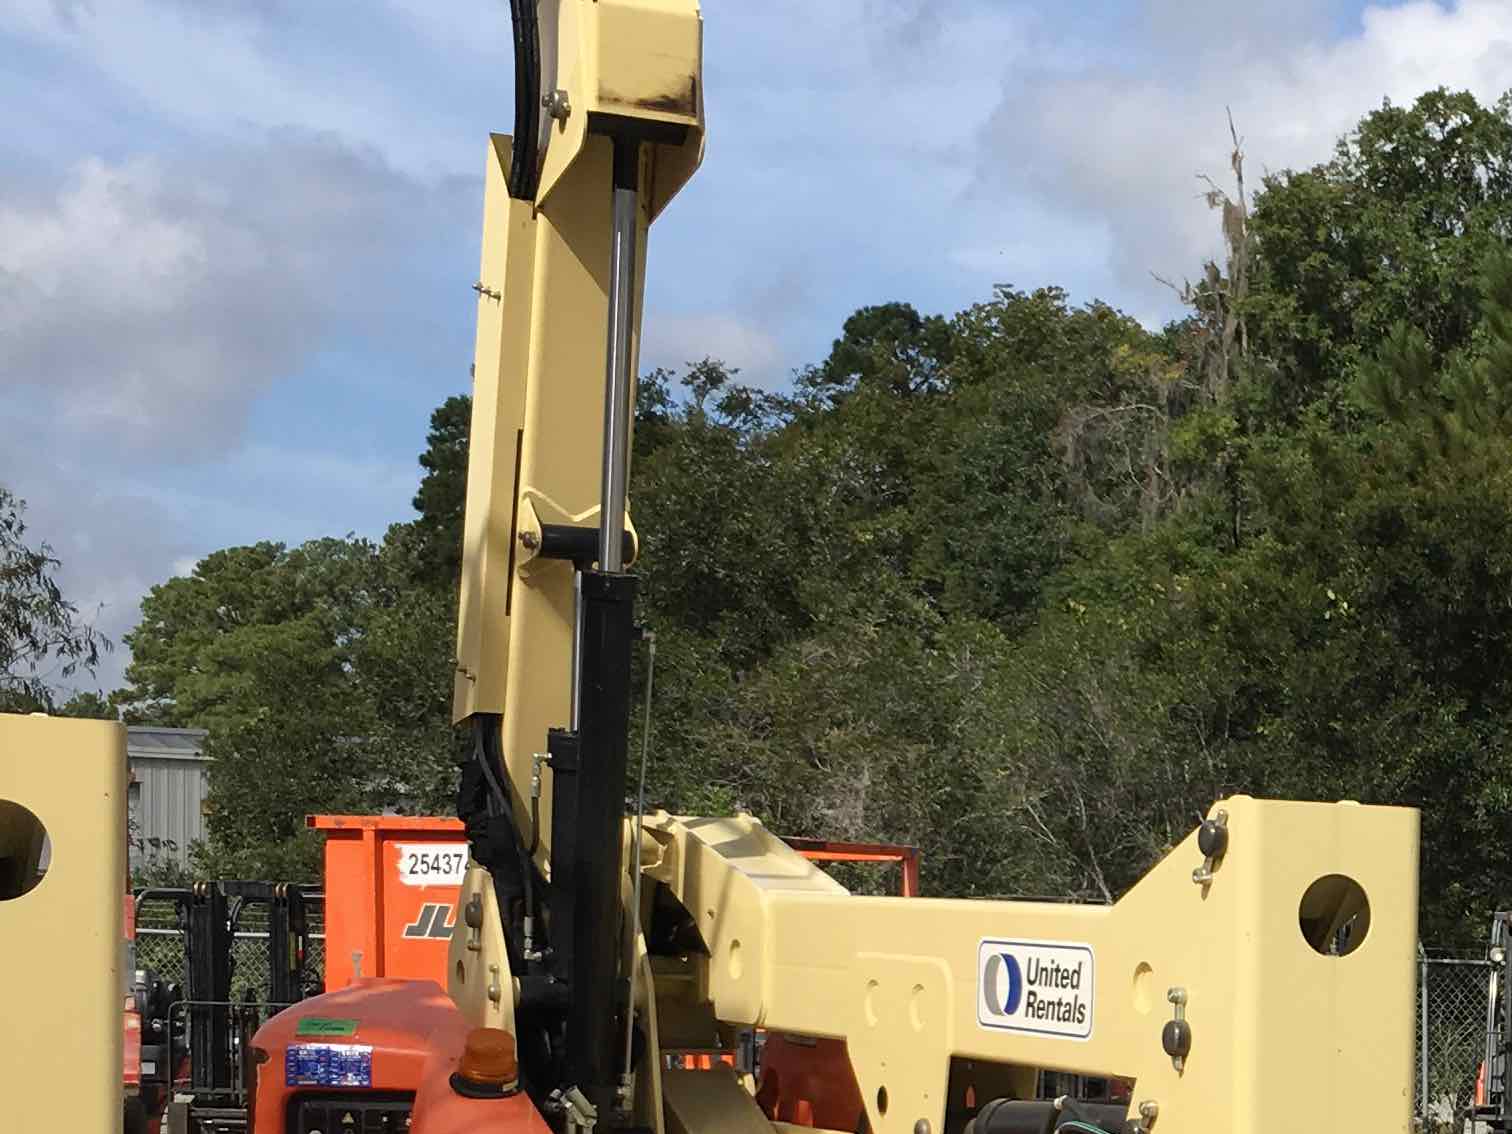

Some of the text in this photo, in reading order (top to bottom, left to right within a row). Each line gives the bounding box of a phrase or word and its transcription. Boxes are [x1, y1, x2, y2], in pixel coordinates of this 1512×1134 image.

[408, 853, 470, 875] 25437
[1026, 956, 1082, 990] United
[1025, 989, 1086, 1024] Rentals
